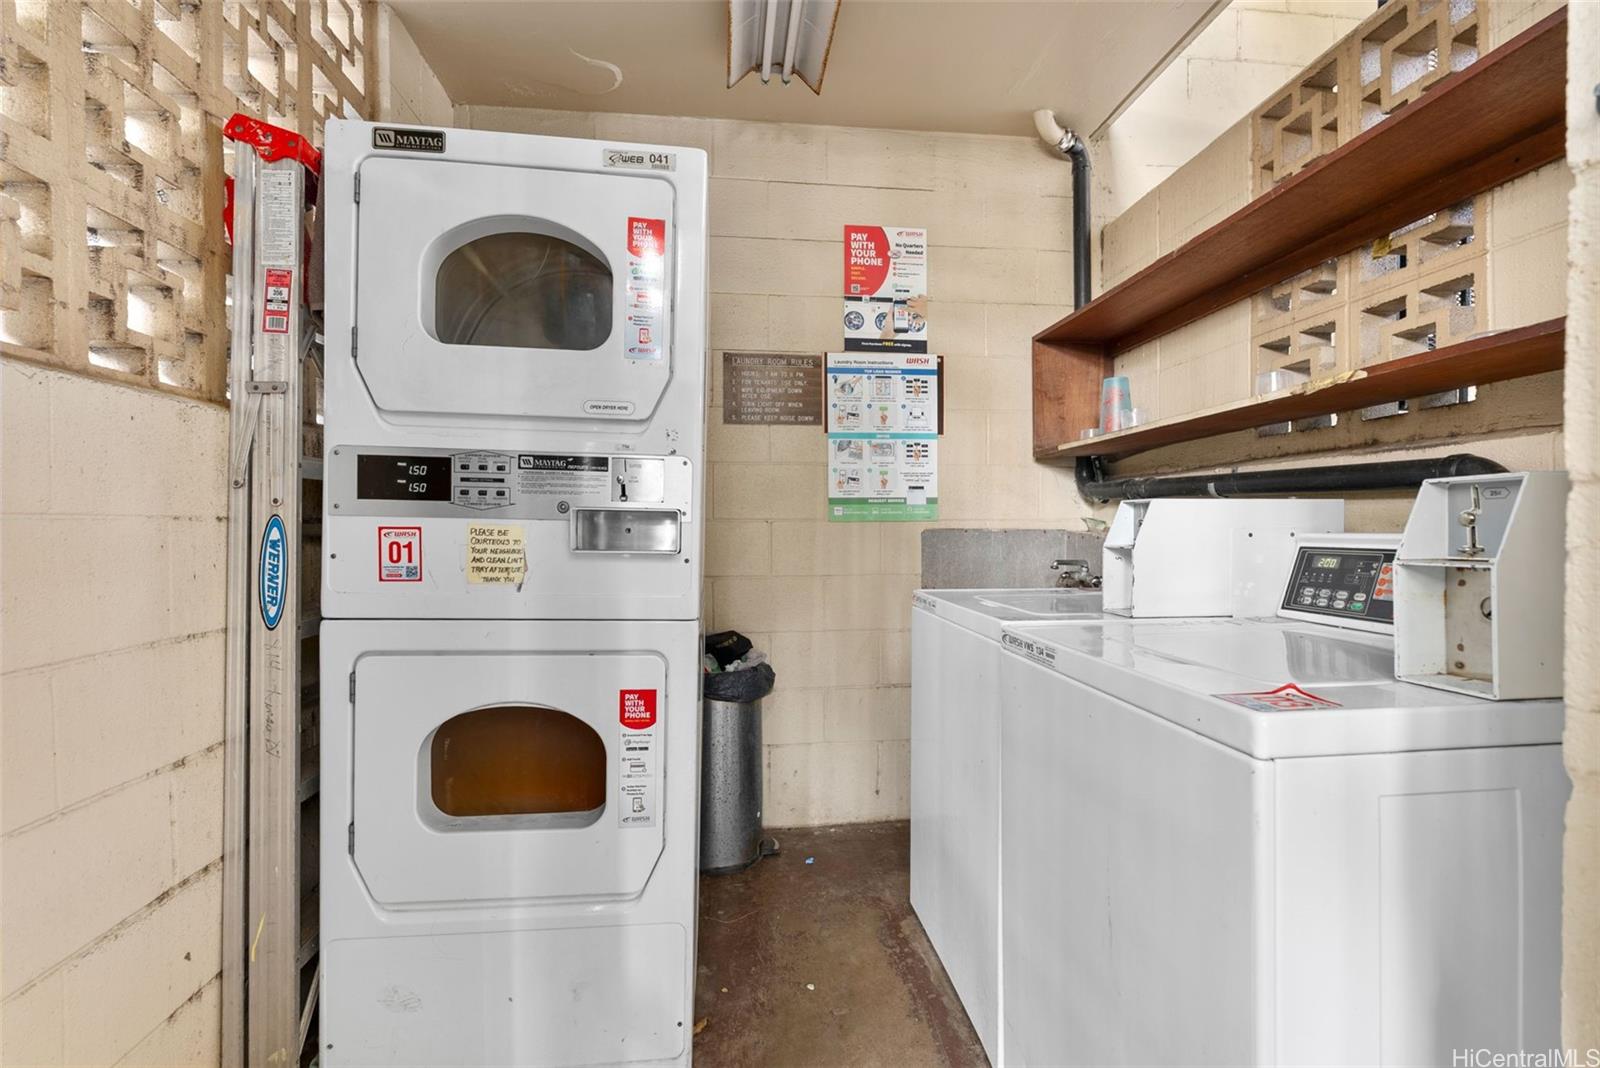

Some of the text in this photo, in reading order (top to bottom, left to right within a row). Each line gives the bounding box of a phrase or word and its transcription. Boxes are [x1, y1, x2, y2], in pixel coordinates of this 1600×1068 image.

[396, 135, 442, 146] MAYTAG
[649, 153, 669, 164] 041
[850, 233, 868, 241] PAY
[850, 241, 875, 249] WITH
[850, 249, 876, 257] YOUR
[850, 257, 883, 266] PHONE
[732, 357, 814, 366] LAUNDRY ROOM RULES
[534, 459, 567, 467] MAYTAG
[470, 528, 495, 536] PLEASE
[471, 537, 510, 545] COURTEOUS
[388, 541, 413, 563] 01
[471, 546, 488, 554] YOUR
[266, 537, 282, 609] WERNER
